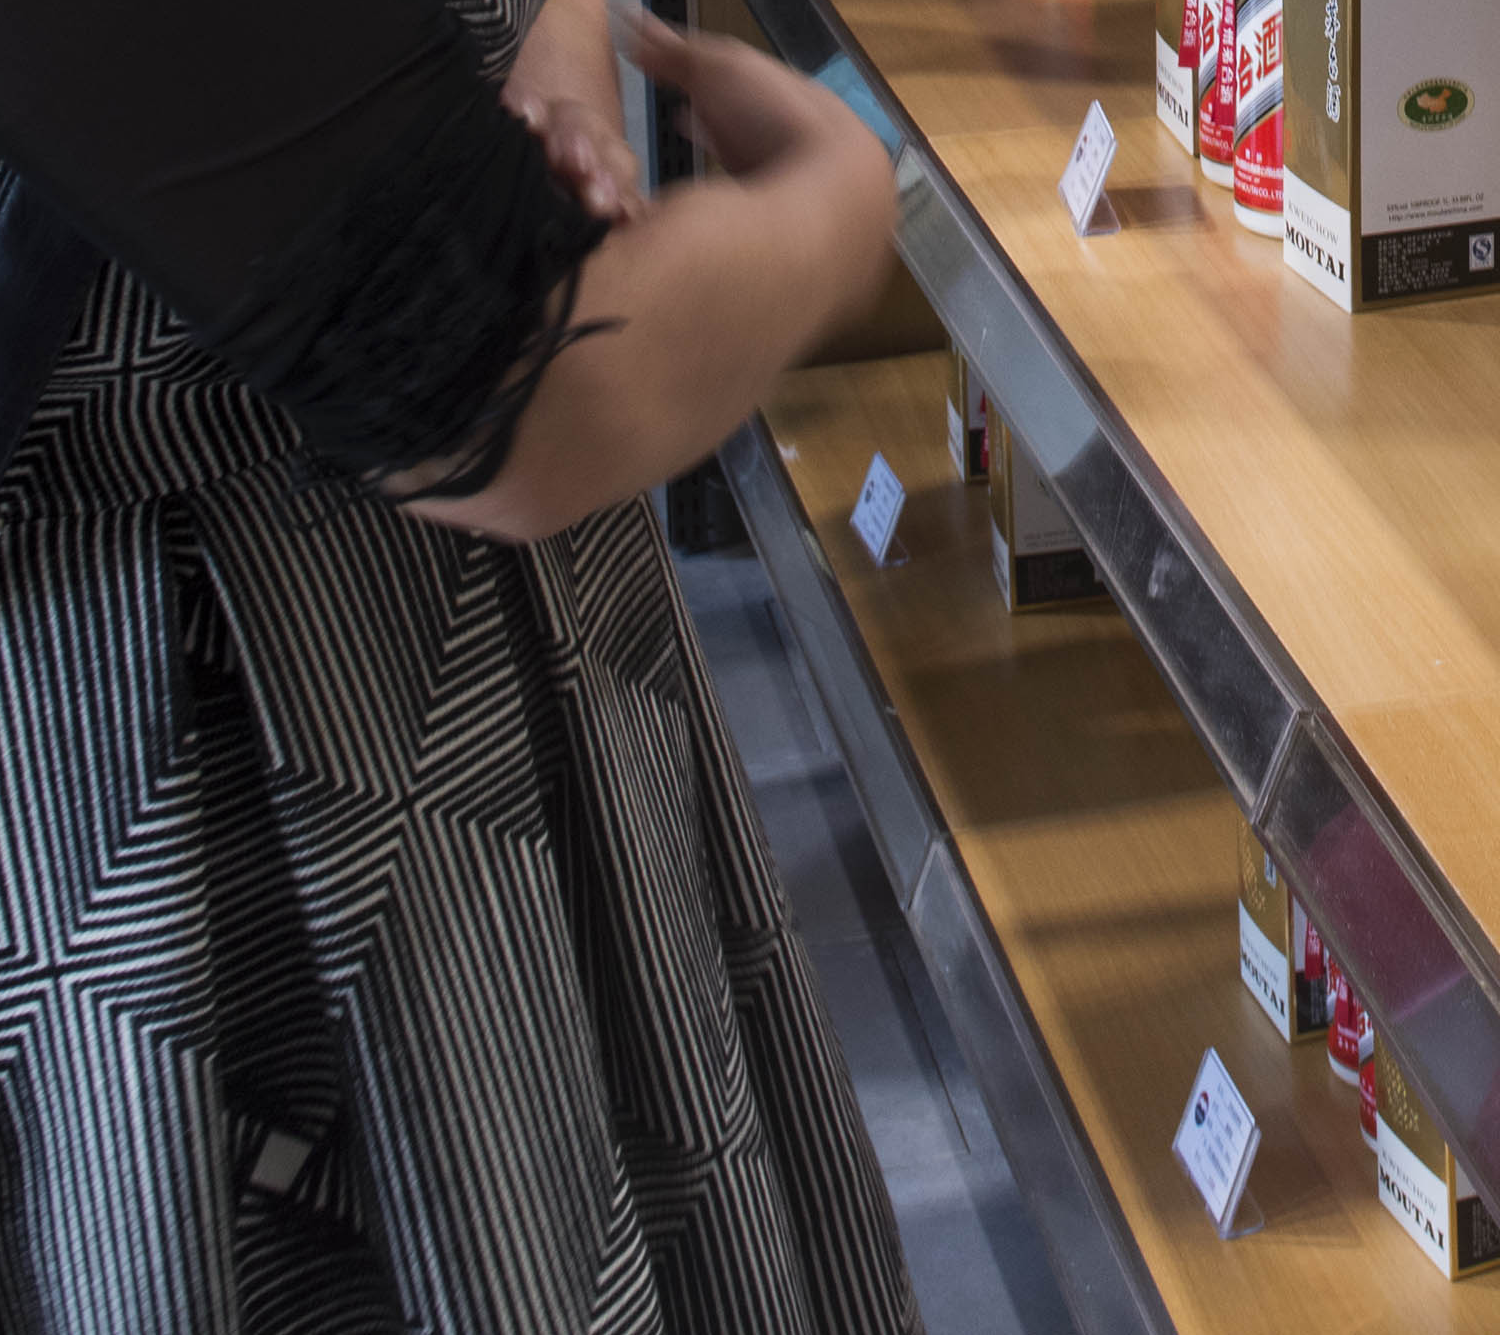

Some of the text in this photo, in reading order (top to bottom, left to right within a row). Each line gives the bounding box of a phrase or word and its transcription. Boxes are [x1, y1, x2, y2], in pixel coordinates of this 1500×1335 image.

[1156, 84, 1189, 130] MOUTAI
[1284, 219, 1346, 285] MOUTAI
[1287, 200, 1339, 247] KWEICHOW
[1240, 948, 1286, 1019] MOUTAI
[1378, 1163, 1446, 1252] MOUTAI
